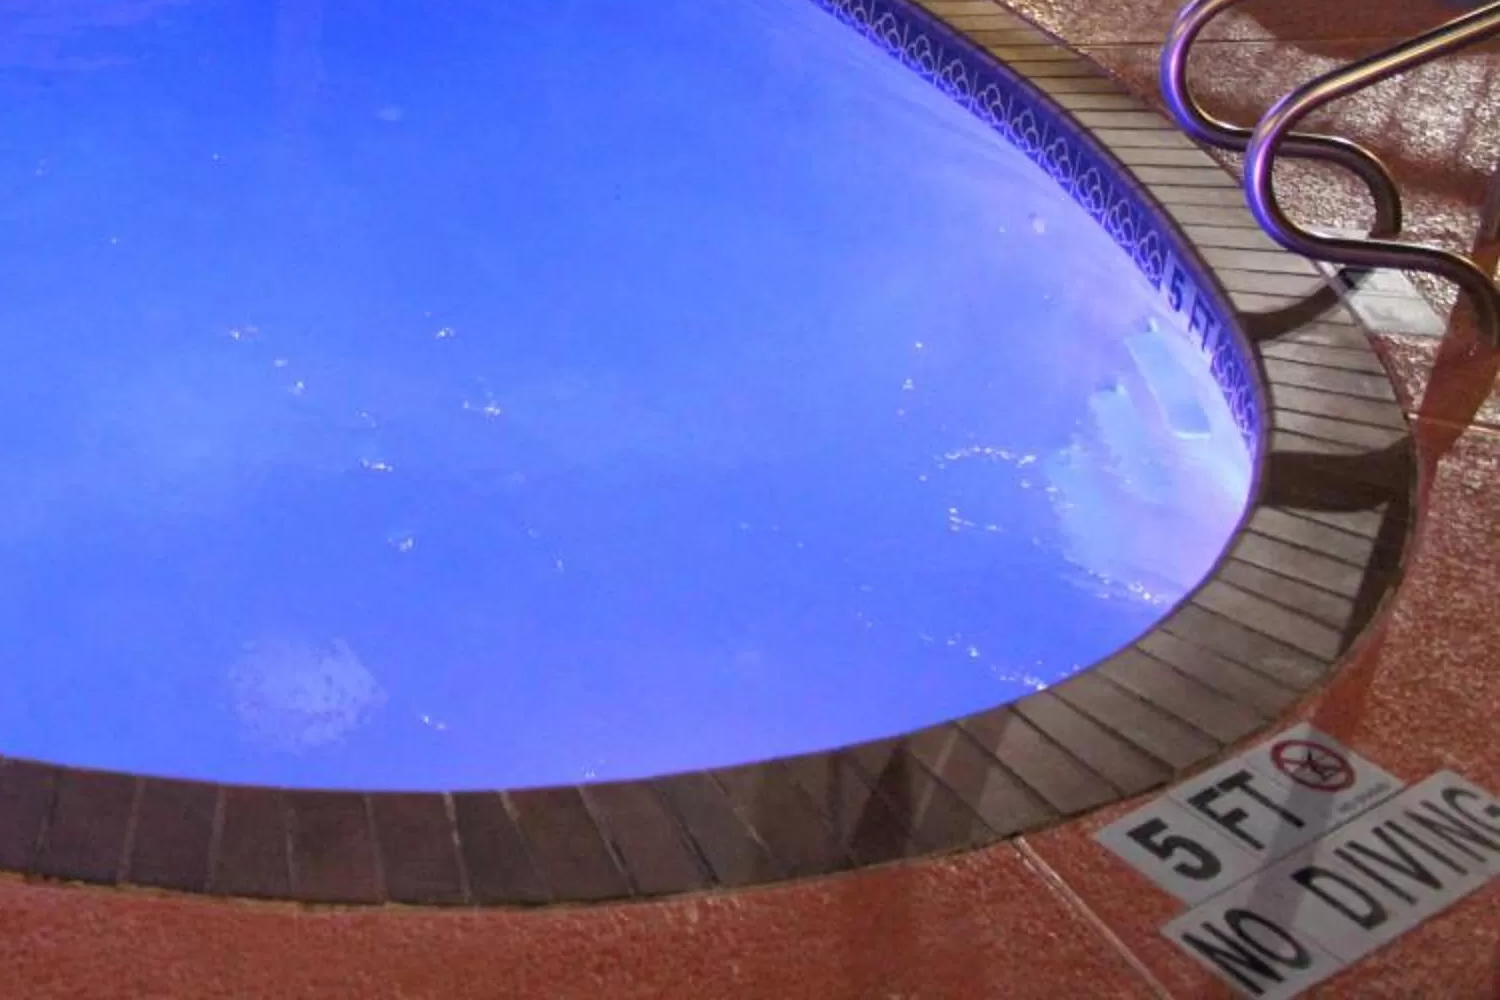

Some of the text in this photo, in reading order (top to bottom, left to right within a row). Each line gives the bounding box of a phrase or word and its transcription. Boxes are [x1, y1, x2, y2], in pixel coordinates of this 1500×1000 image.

[1169, 264, 1186, 312] 5
[1127, 818, 1222, 881] 5
[1187, 769, 1306, 851] FT
[1181, 907, 1311, 996] NO
